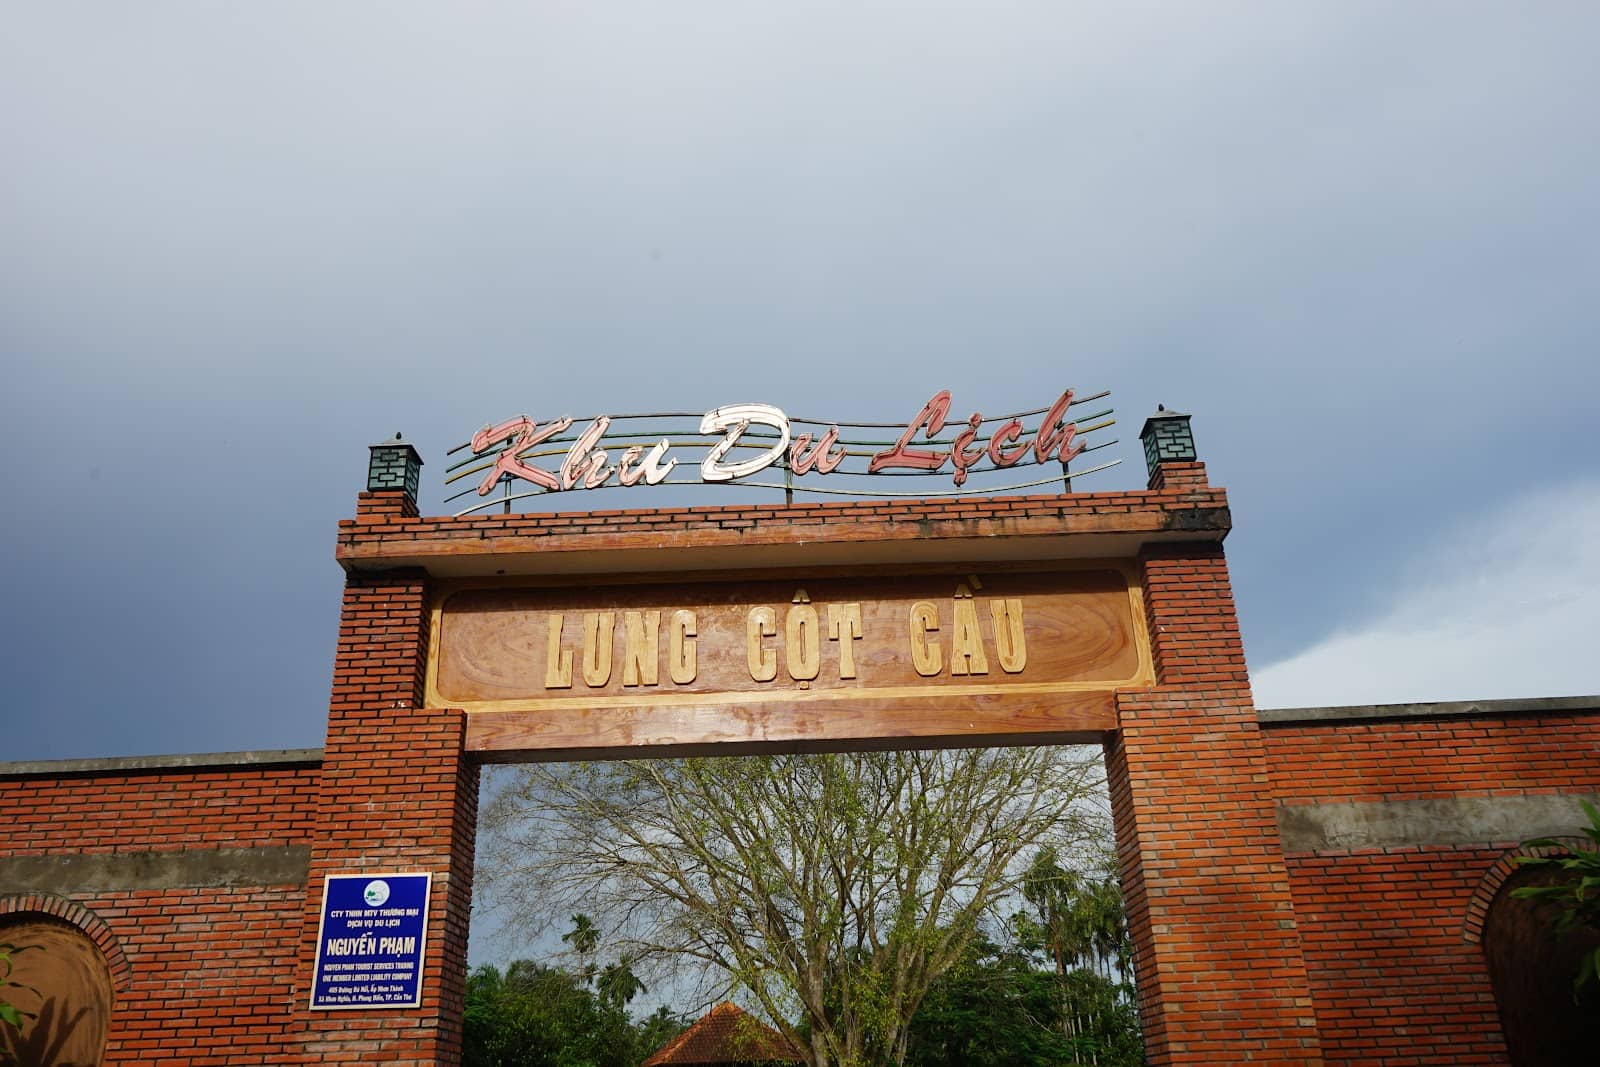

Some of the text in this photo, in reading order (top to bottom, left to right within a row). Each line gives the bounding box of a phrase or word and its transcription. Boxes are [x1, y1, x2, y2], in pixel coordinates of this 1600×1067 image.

[471, 388, 1087, 496] Khu Du Lịch
[545, 574, 1027, 690] LUNG CỘT CẦU
[331, 910, 344, 918] CTY
[364, 909, 378, 917] MTV
[347, 919, 363, 928] DỊCH
[374, 919, 384, 927] DU
[385, 919, 400, 928] LỊCH
[326, 931, 415, 958] NGUYỄN PHẠM
